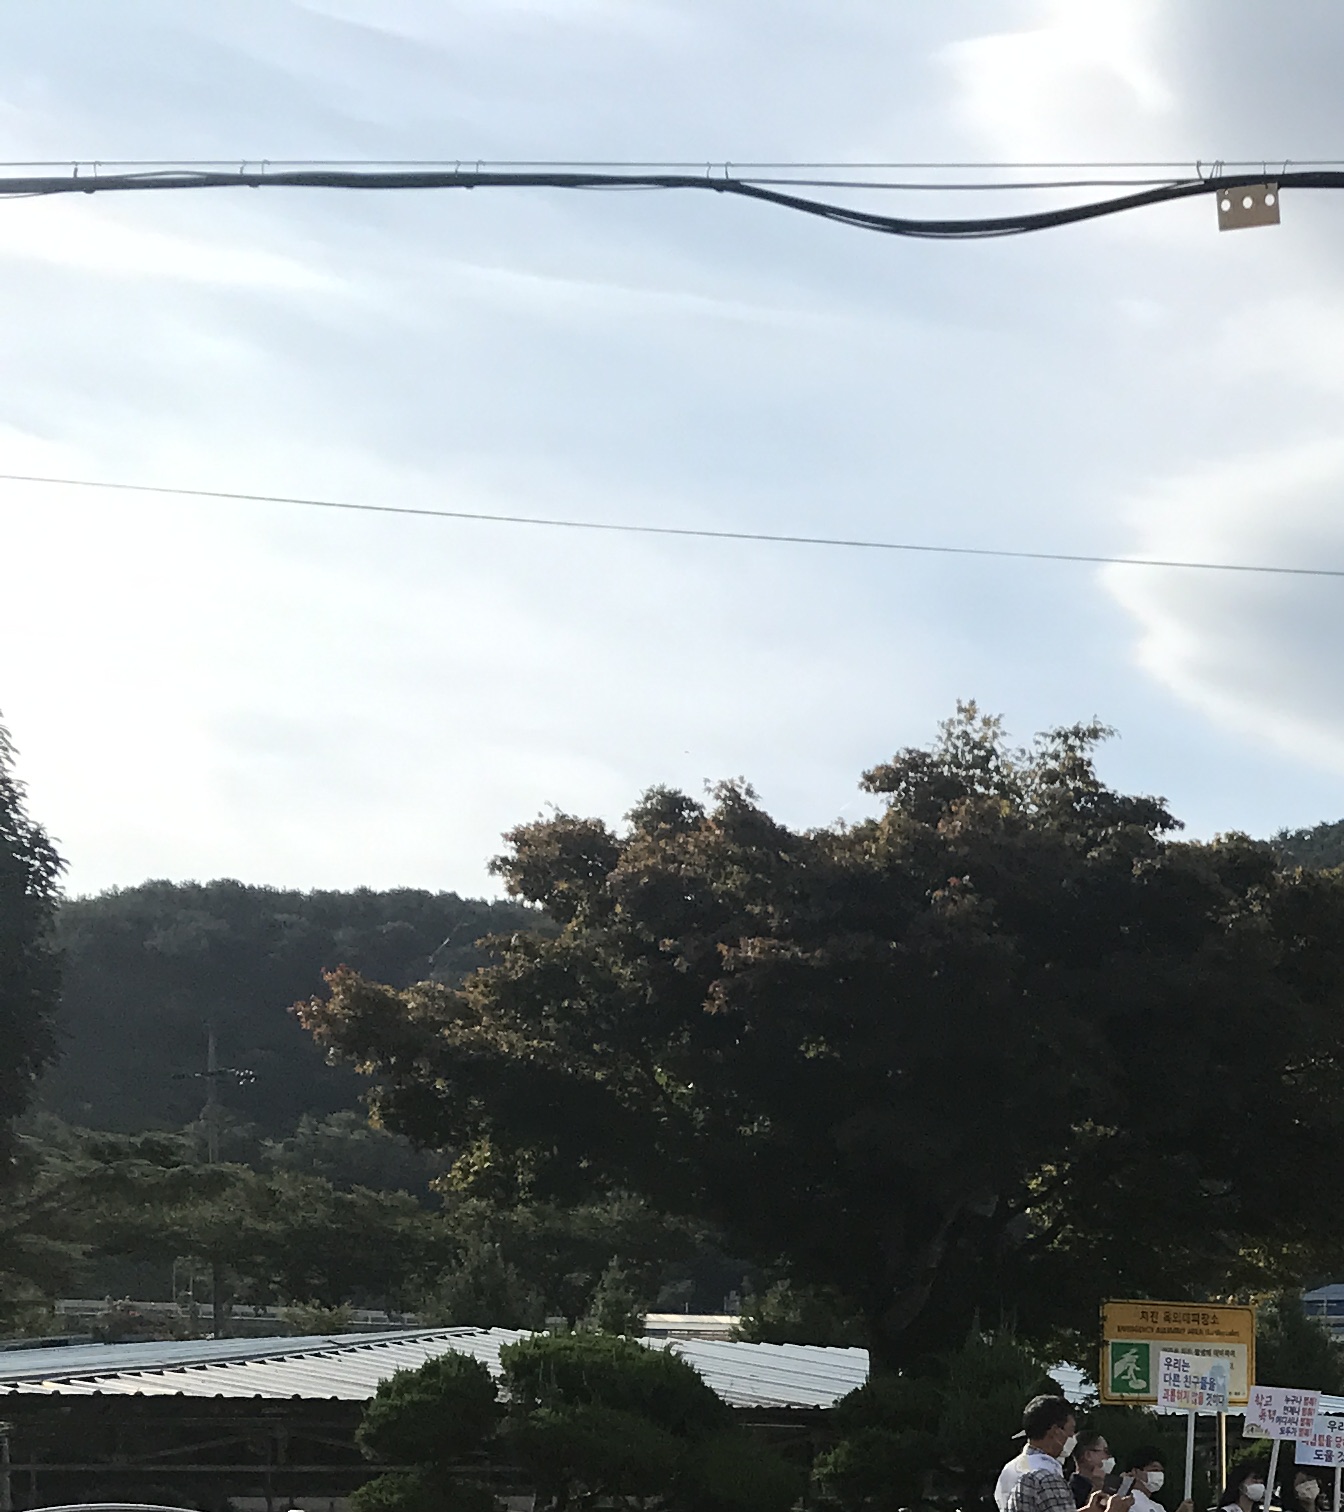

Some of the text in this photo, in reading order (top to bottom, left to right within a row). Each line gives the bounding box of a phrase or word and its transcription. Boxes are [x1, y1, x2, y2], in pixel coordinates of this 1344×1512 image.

[1163, 1356, 1191, 1373] 우리는
[1163, 1373, 1217, 1392] 다른 친구들을
